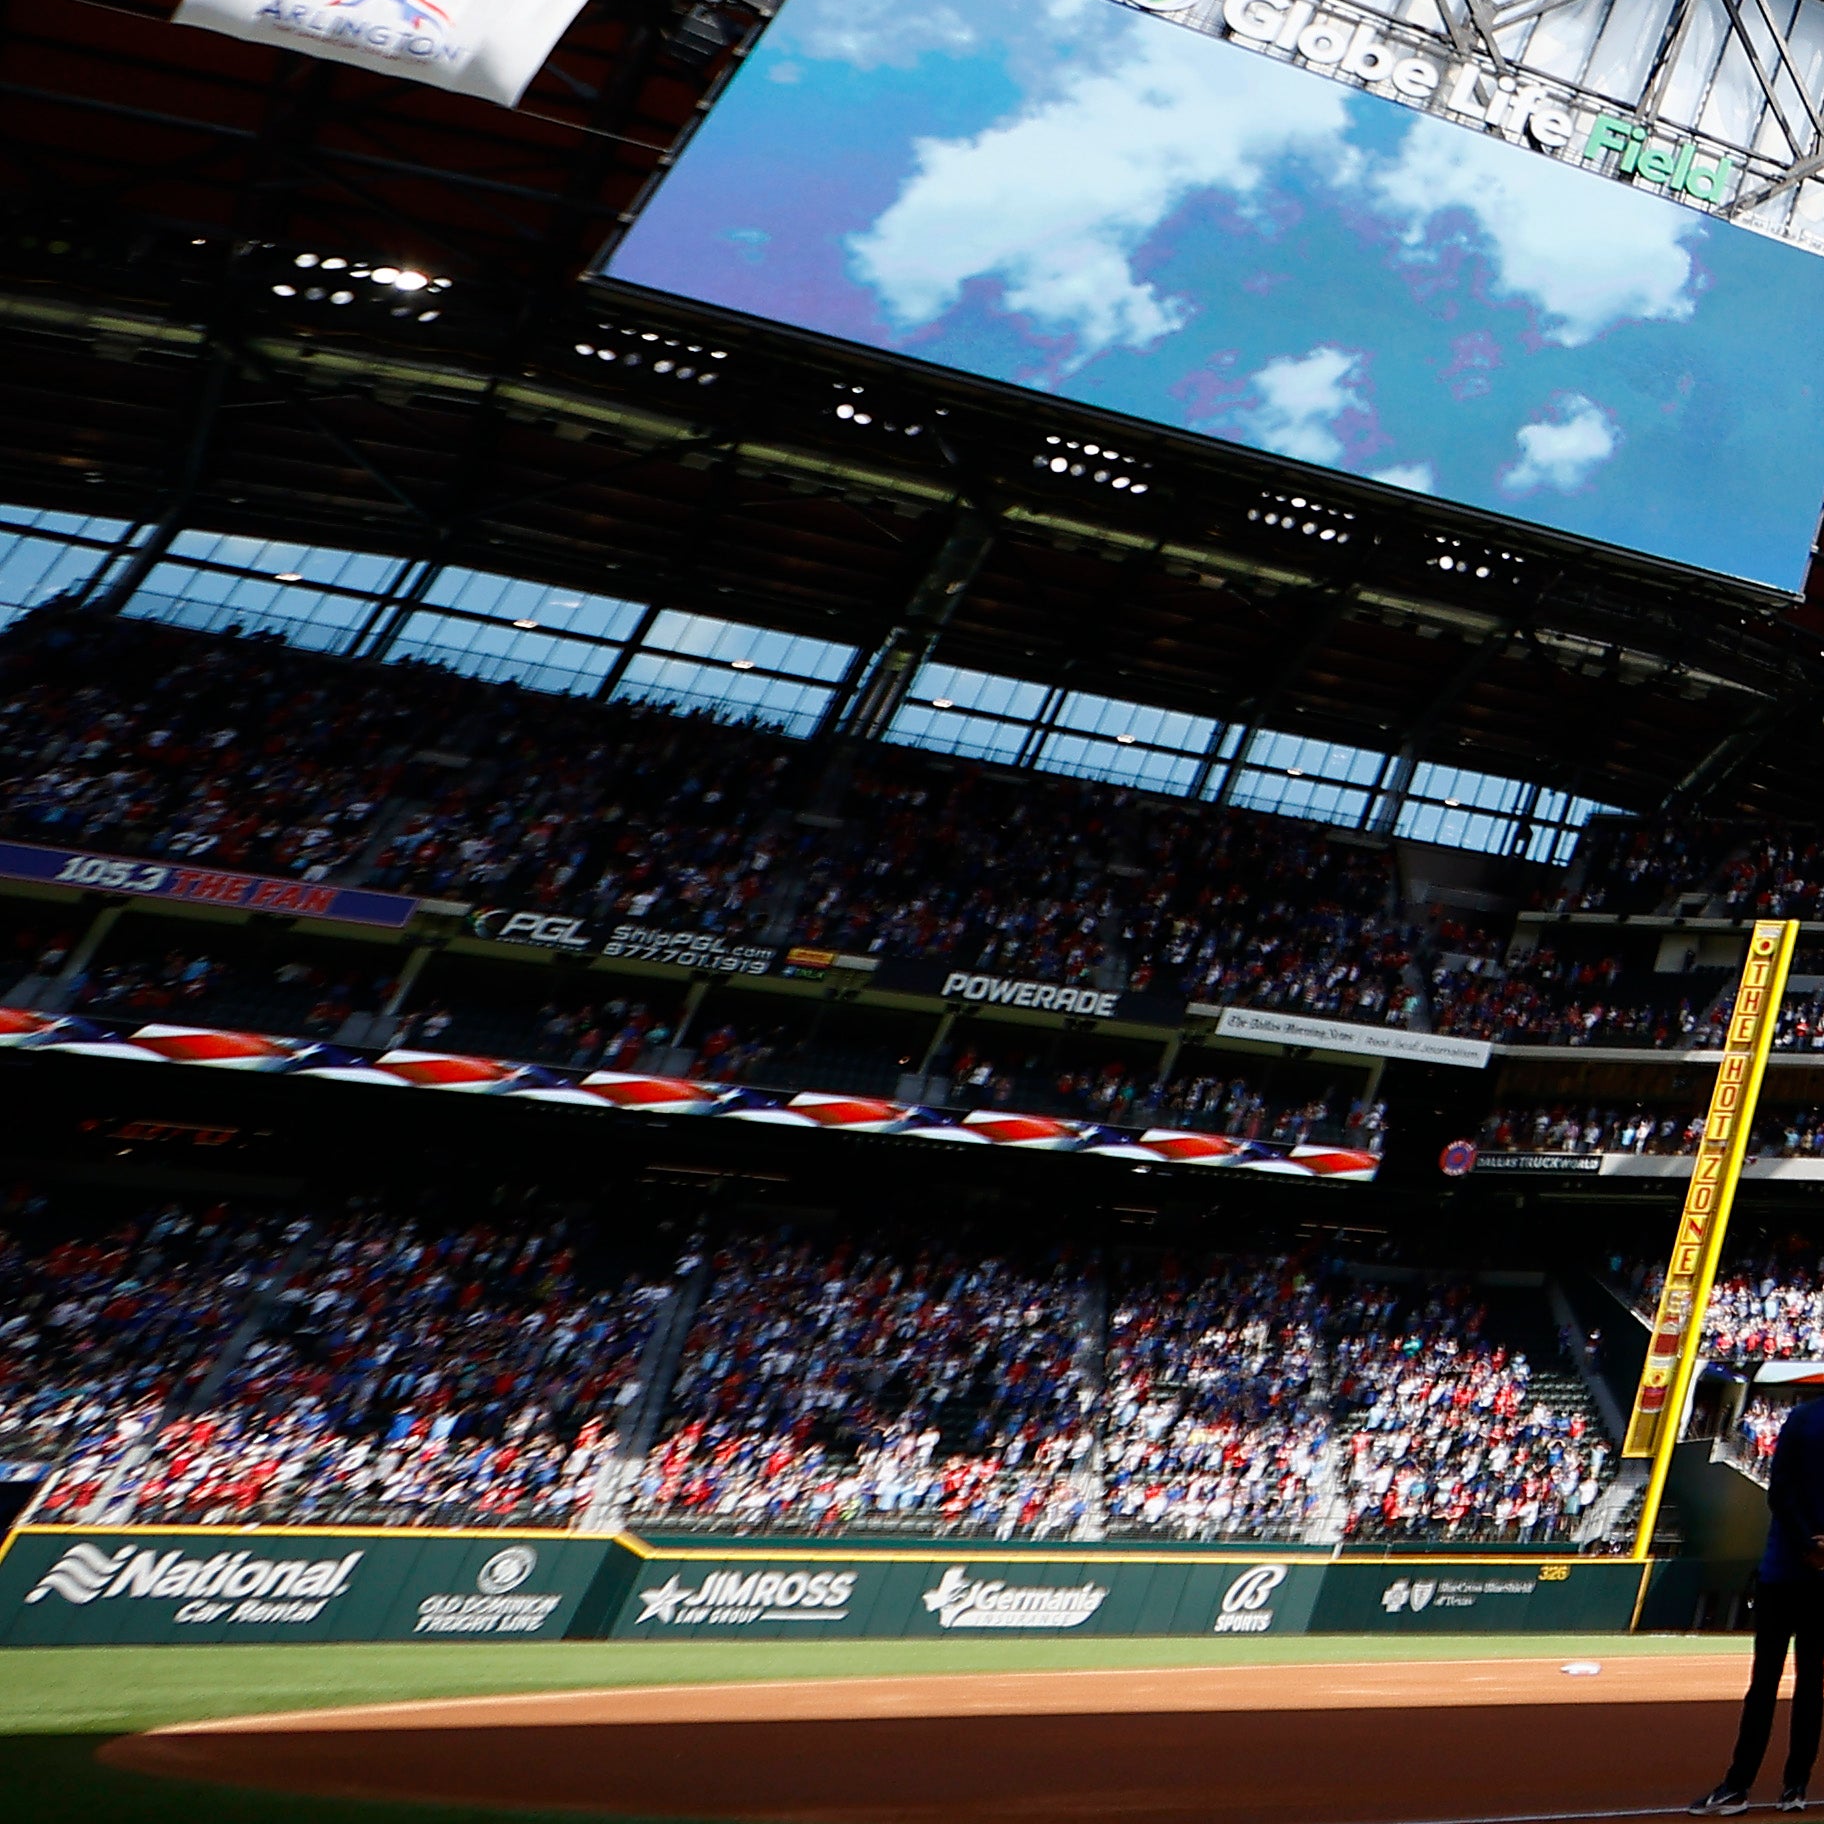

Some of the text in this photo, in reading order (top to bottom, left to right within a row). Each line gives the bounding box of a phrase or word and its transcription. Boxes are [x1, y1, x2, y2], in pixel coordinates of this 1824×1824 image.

[1447, 62, 1573, 148] Life
[1584, 113, 1735, 205] Field
[54, 856, 337, 914] 105.3 THE FAN
[496, 909, 592, 947] PGL
[611, 923, 777, 960] ShipPGL.com
[941, 969, 1123, 1018] POWERADE
[1680, 964, 1765, 1272] THE HOT ZONE
[417, 1594, 464, 1615] OLD
[974, 1580, 1111, 1611] Germania
[1222, 1564, 1288, 1612] B
[173, 1598, 330, 1623] Car Rental
[674, 1607, 765, 1624] LAW GROUP
[1214, 1610, 1274, 1632] SPORTS
